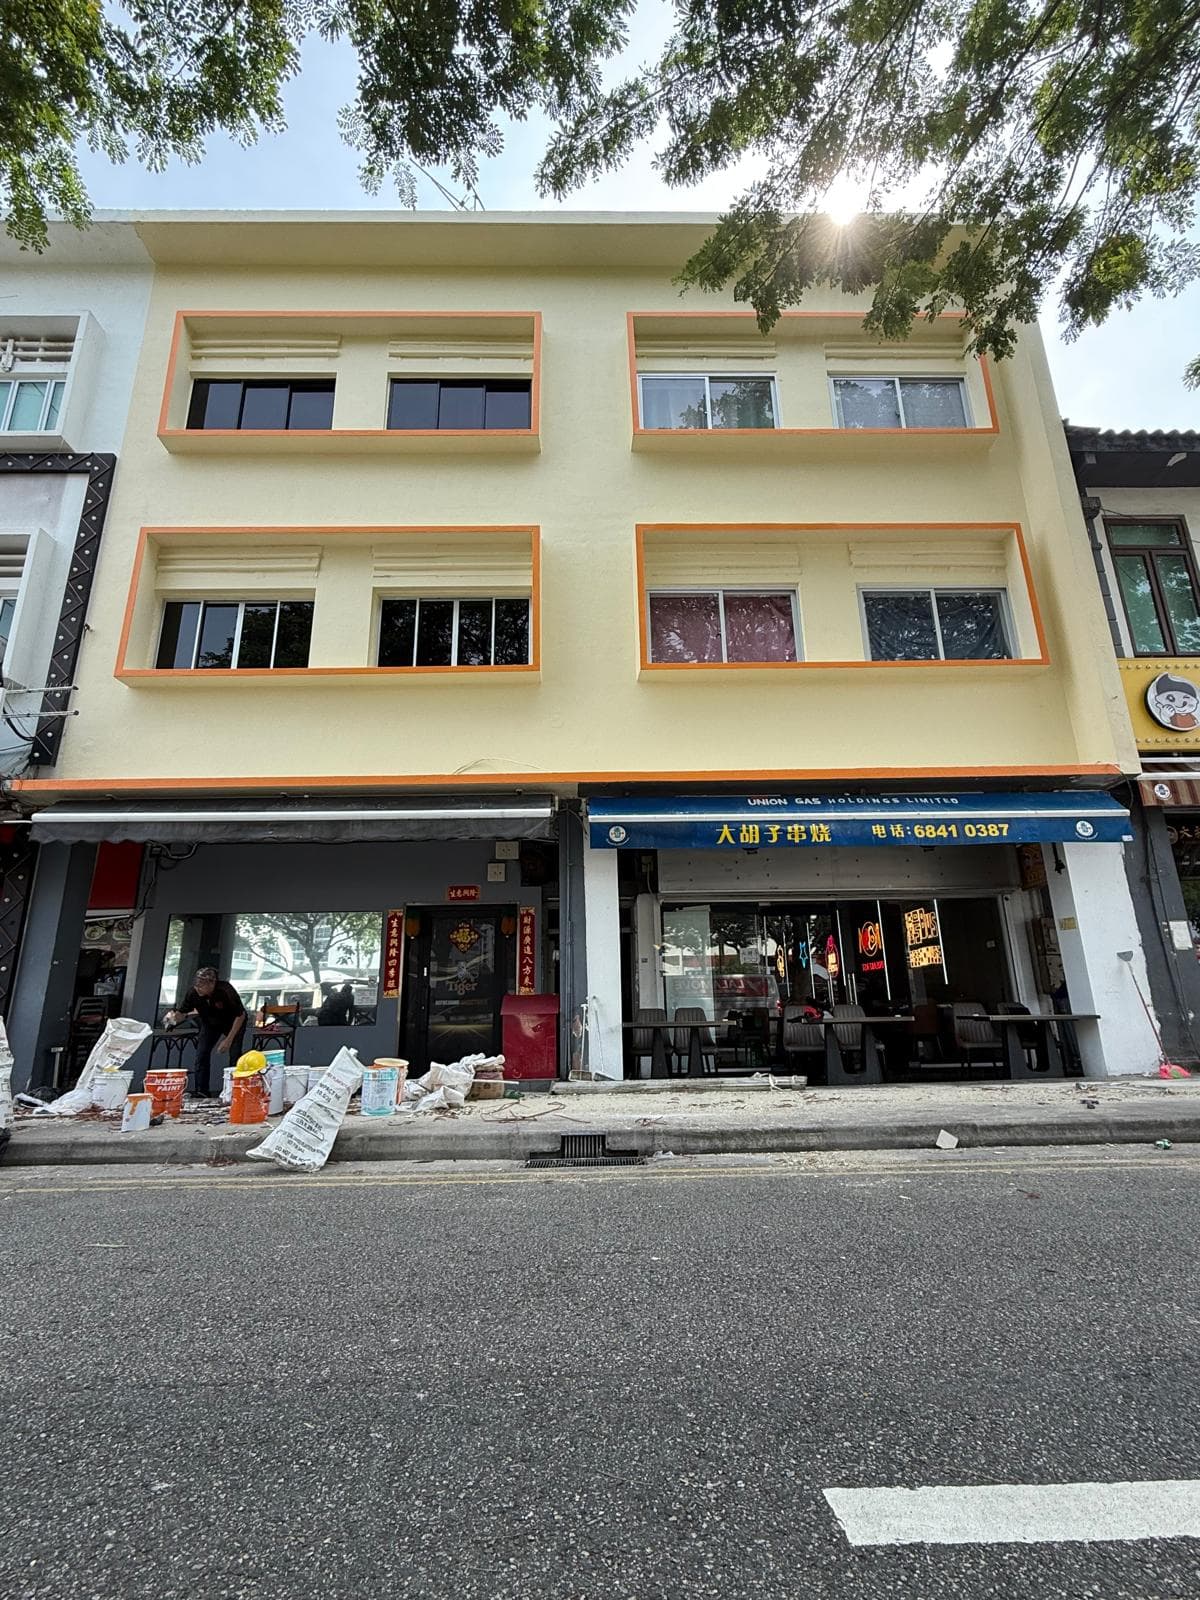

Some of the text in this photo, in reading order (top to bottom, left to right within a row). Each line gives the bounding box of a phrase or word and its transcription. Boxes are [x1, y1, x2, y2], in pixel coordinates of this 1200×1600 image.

[747, 797, 788, 806] UNION
[795, 797, 822, 805] GAS
[715, 823, 832, 845] 大胡子串烧
[964, 823, 1009, 837] 0387
[446, 980, 479, 995] Tiger
